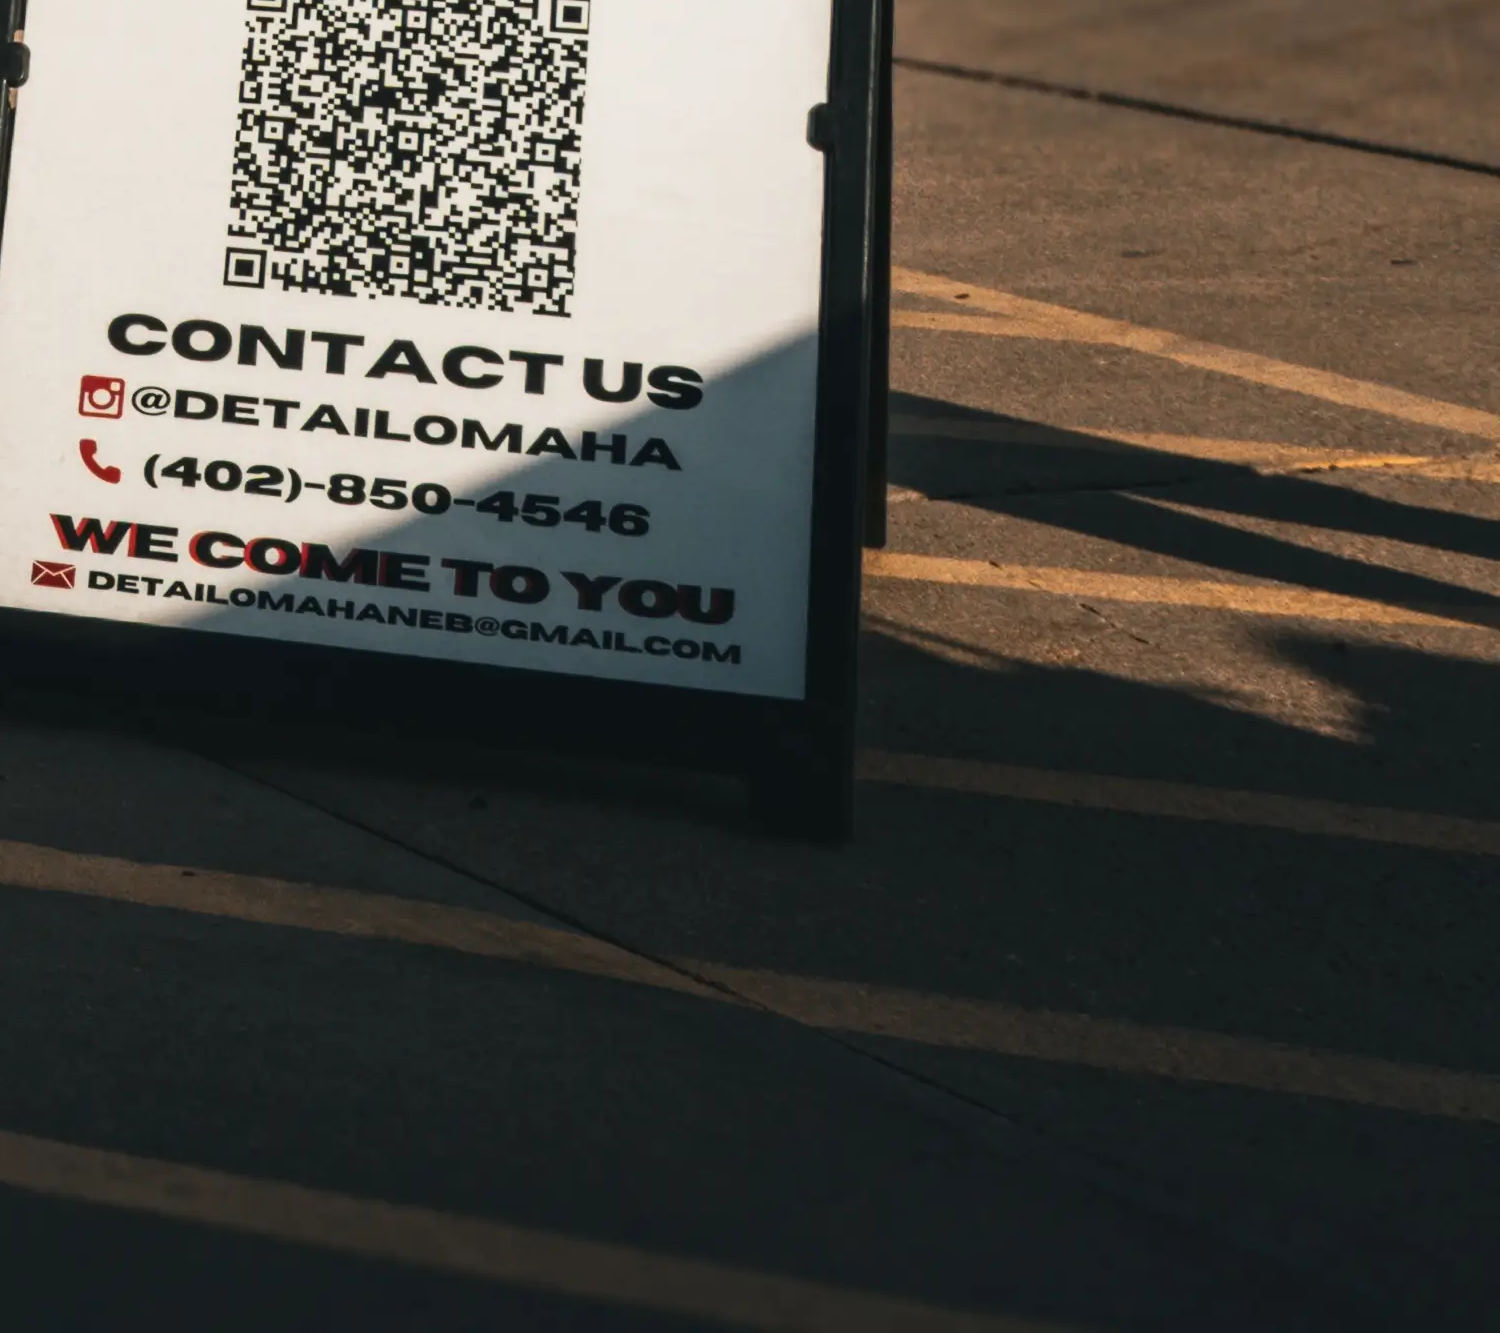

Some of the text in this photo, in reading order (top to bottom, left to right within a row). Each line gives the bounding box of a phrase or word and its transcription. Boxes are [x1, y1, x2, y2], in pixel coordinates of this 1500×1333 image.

[108, 313, 704, 410] CONTACT US
[131, 386, 682, 471] @DETAILOMAHA
[144, 454, 650, 536] (402)-850-4546
[49, 513, 734, 623] WE COME TO YOU
[88, 571, 740, 663] DETAILOMAHANEB@GMAIL.COM
